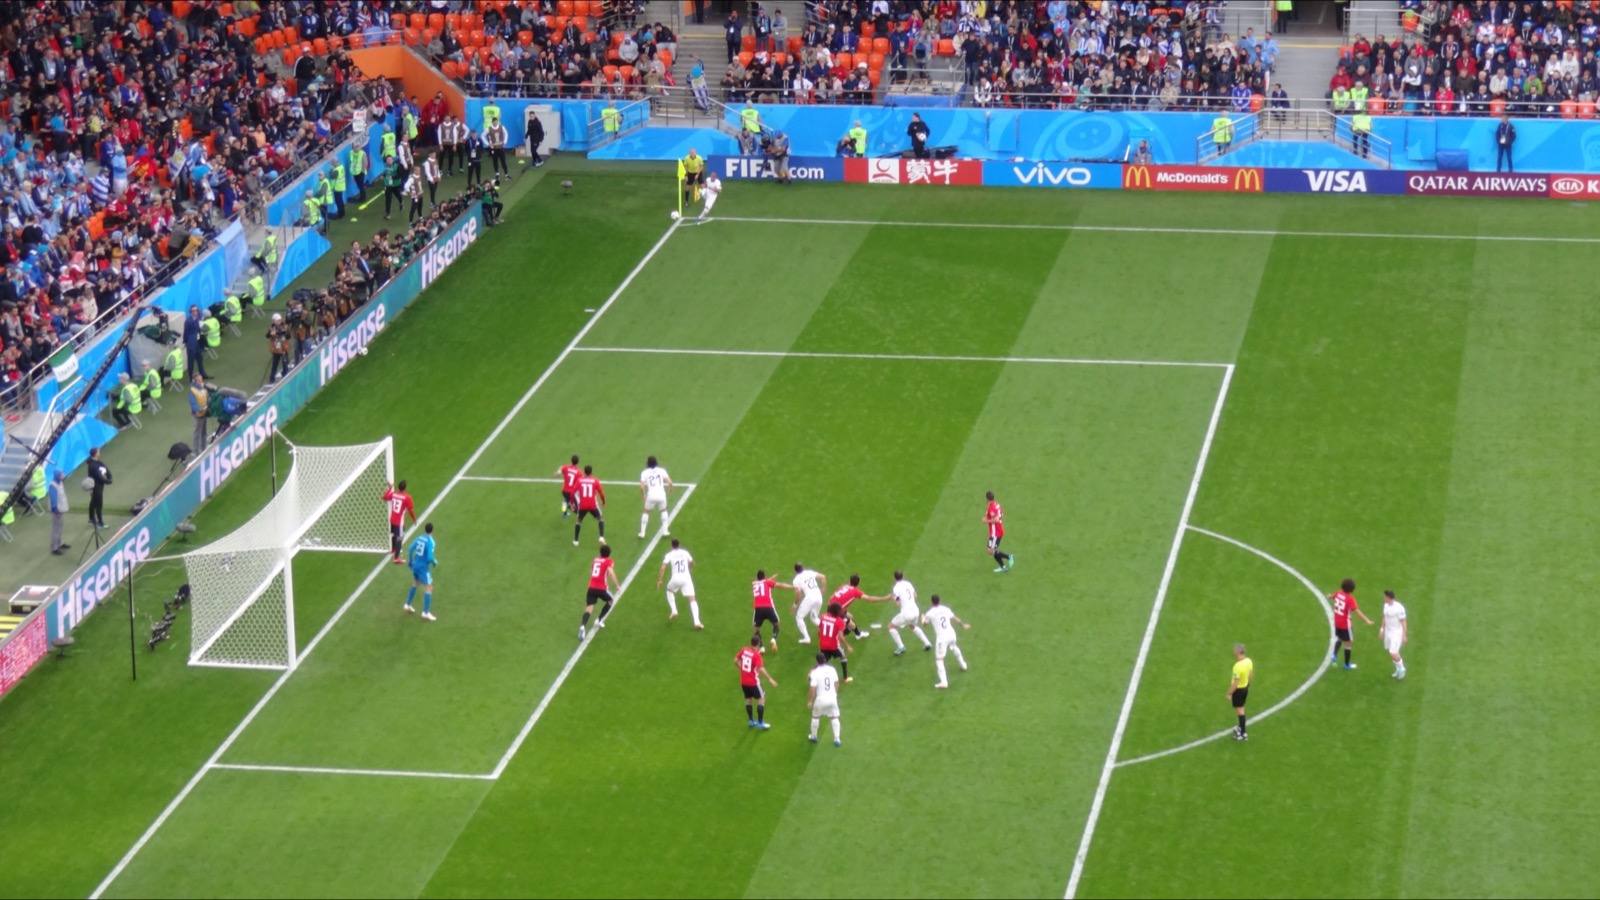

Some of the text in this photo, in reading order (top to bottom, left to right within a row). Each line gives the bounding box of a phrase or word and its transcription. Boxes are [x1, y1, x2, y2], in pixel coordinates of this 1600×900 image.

[725, 158, 825, 179] FIFAcom
[906, 158, 959, 185] 蒙牛
[1156, 171, 1229, 185] McDonald's
[1302, 170, 1367, 192] VISA
[1409, 175, 1547, 193] QATAR AIRWAYS
[1555, 180, 1581, 192] KIA
[421, 216, 478, 290] Hisense
[320, 303, 386, 387] Hisense
[200, 405, 278, 501] Hisense
[567, 472, 575, 486] 7
[581, 483, 593, 497] 11
[592, 562, 602, 577] 6
[674, 560, 686, 574] 15
[57, 526, 150, 639] Hisense
[752, 583, 765, 597] 21
[824, 676, 831, 691] 9
